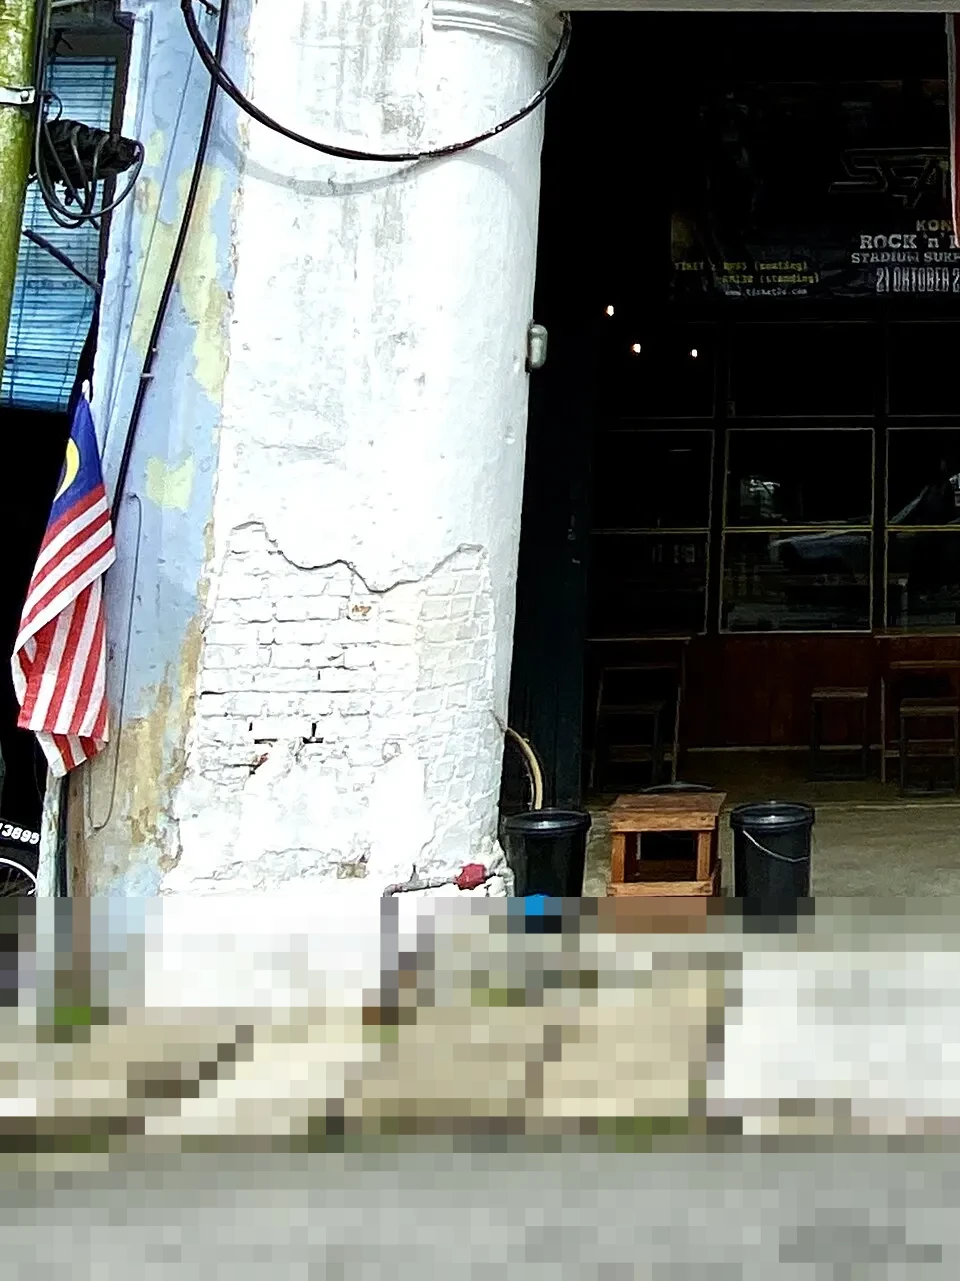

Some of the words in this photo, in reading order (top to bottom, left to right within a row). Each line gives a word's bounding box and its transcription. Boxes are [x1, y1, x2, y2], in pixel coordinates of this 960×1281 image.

[859, 234, 918, 250] ROCK
[875, 267, 890, 293] 21
[893, 267, 950, 293] OKTOBER
